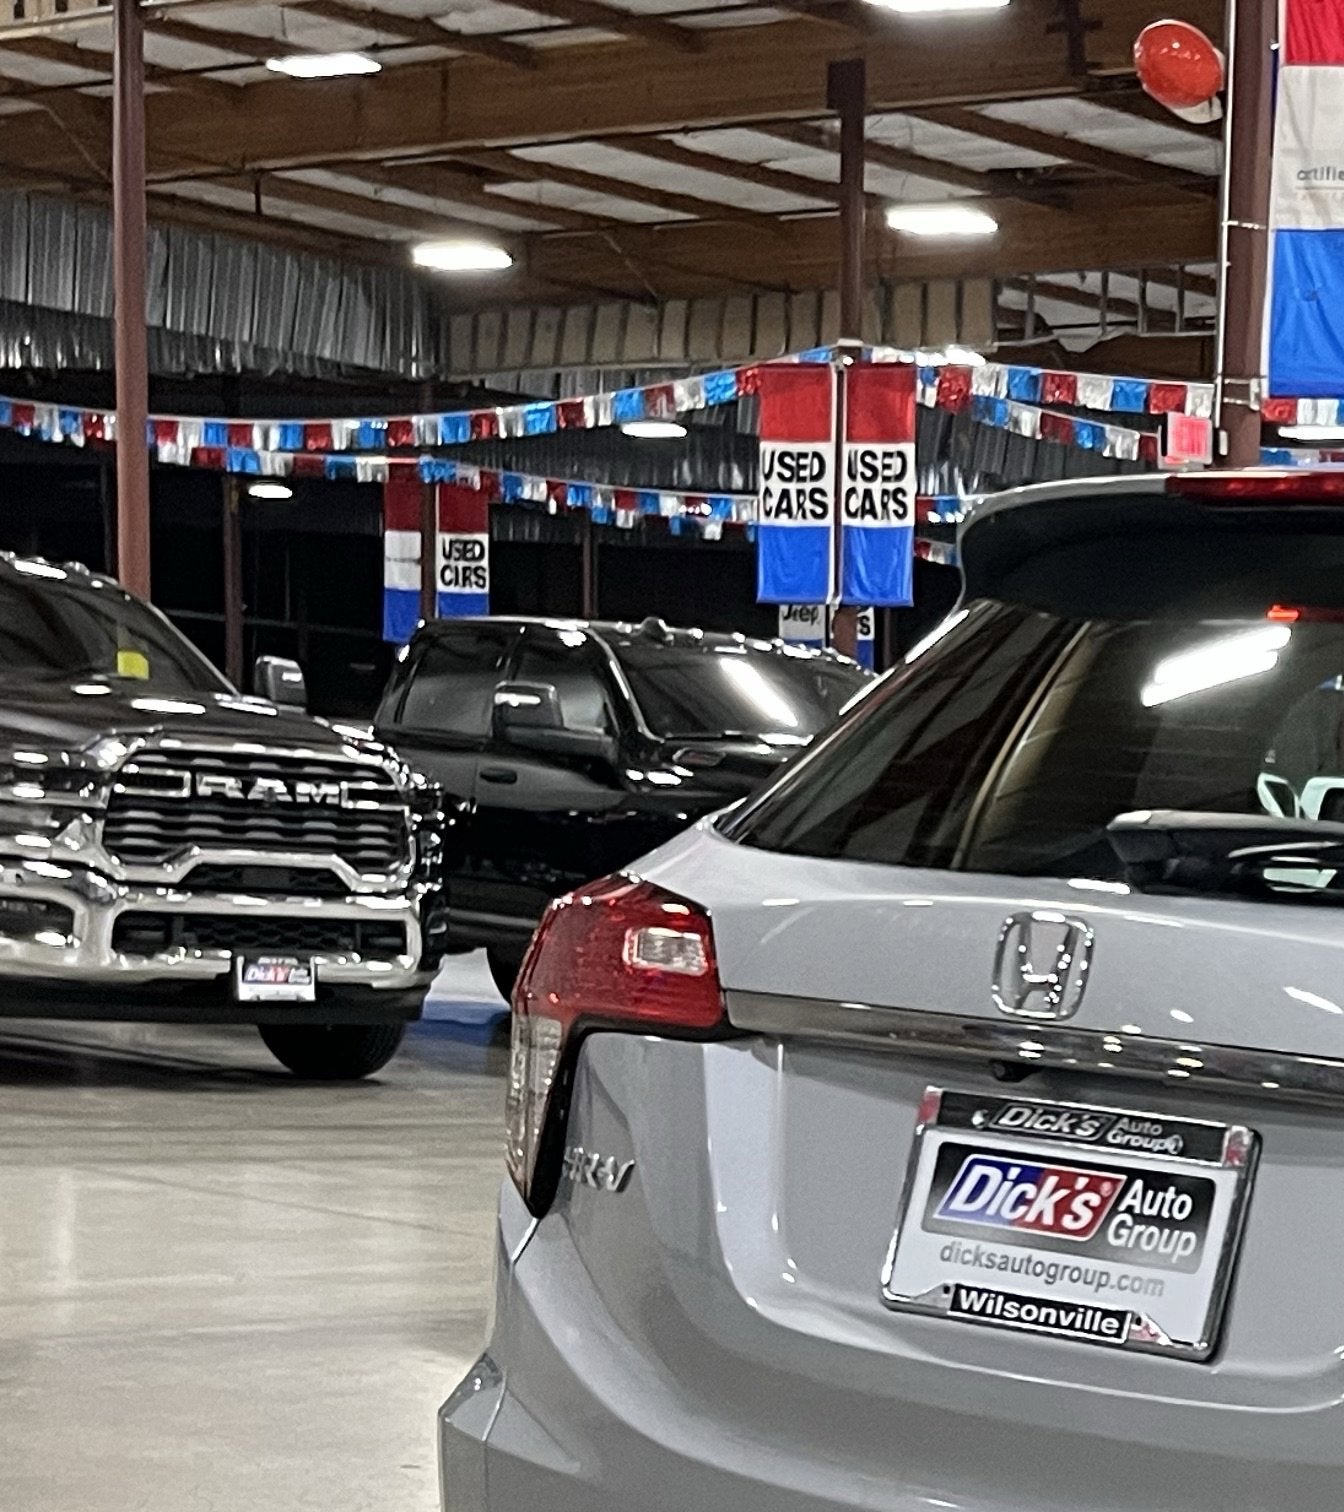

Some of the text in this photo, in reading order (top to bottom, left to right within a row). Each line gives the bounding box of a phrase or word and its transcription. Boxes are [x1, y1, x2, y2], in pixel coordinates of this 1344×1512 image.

[762, 450, 827, 483] USED
[847, 449, 908, 483] USED
[762, 486, 829, 521] CARS
[844, 486, 908, 521] CARS
[442, 537, 486, 562] USED
[196, 776, 341, 804] RAM
[999, 1105, 1163, 1137] Dick's Auto
[949, 1163, 1193, 1231] Dick's Auto
[1107, 1213, 1198, 1264] Group
[939, 1241, 1166, 1298] dicksautogroup.com
[959, 1288, 1121, 1335] Wilsonville
